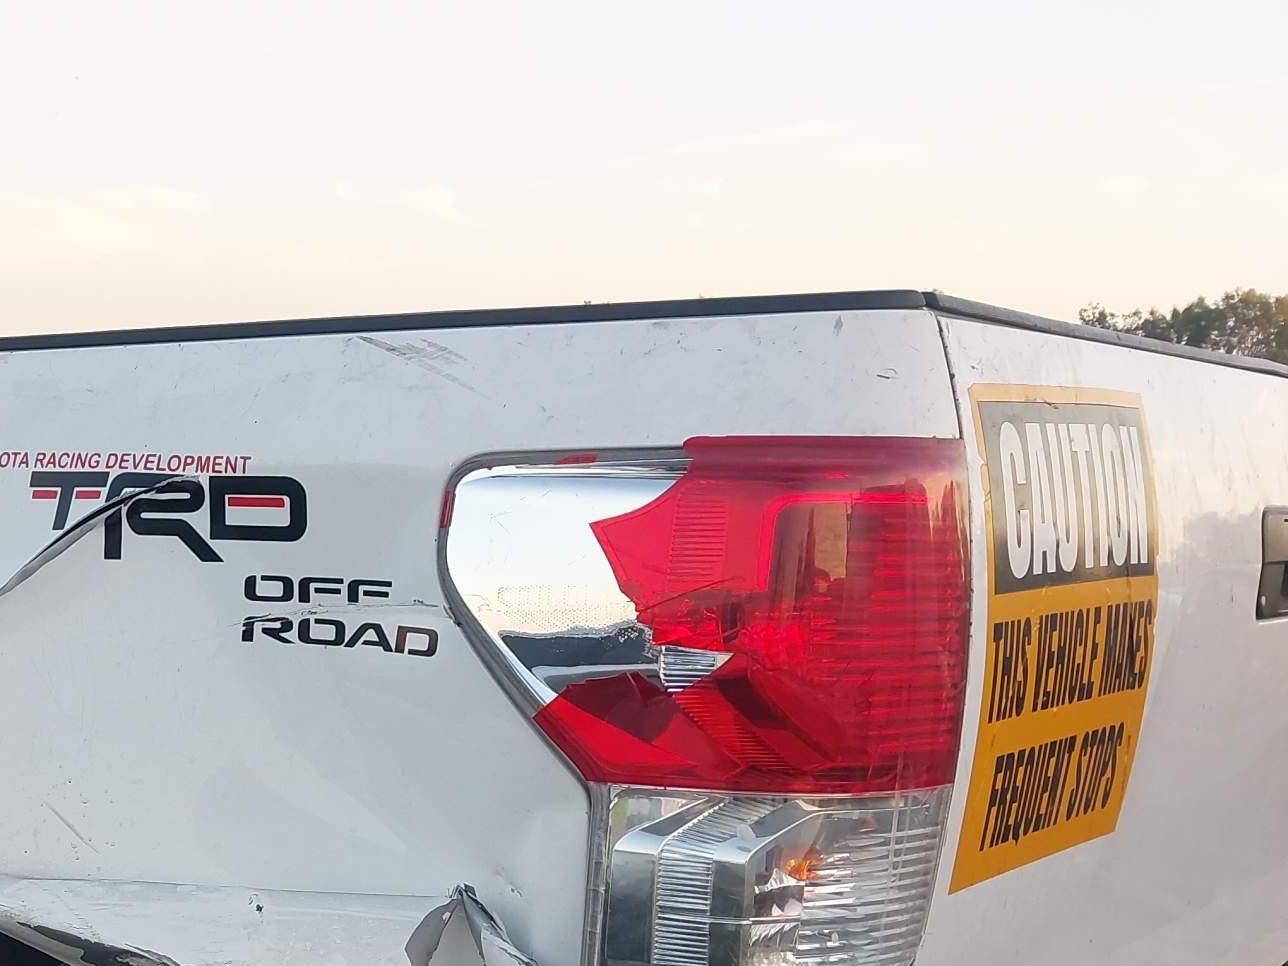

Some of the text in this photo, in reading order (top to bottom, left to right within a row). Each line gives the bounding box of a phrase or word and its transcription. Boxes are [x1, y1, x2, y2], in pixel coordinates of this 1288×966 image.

[34, 452, 101, 470] RACING
[105, 453, 253, 475] DEVELOPMENT
[999, 421, 1149, 579] CAUTION
[29, 471, 308, 563] TRD
[243, 574, 393, 604] OFF
[241, 615, 439, 657] ROAD
[986, 599, 1153, 724] THIS VEHICLE MAKES
[979, 721, 1125, 852] FREQUENT STOPS
